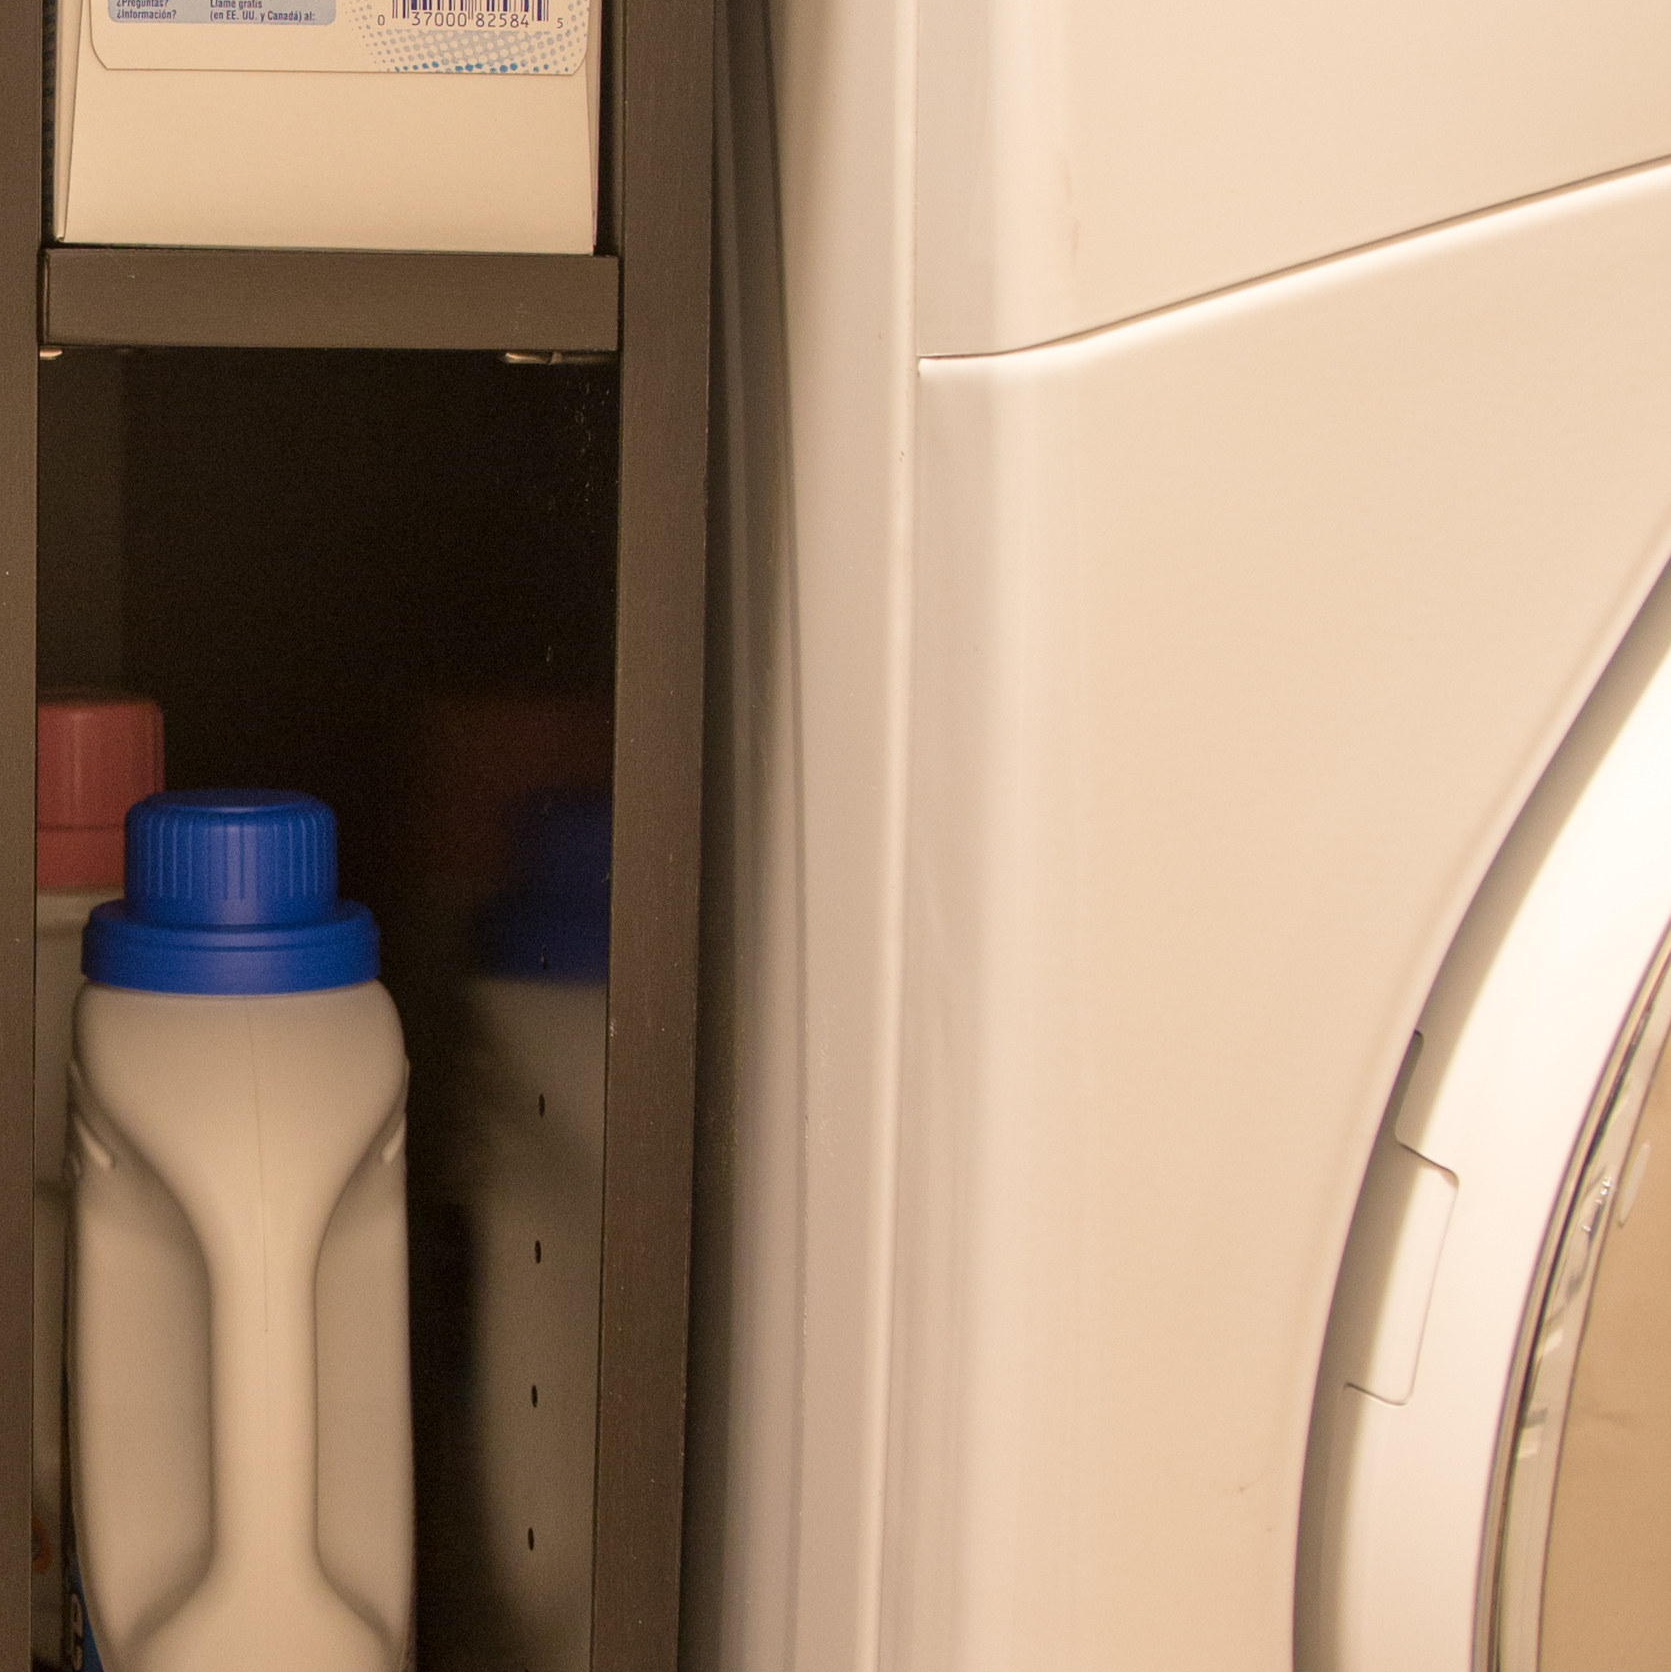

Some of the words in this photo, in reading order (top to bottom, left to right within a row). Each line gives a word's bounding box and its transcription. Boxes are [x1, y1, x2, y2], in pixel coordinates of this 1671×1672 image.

[116, 9, 177, 20] ¿Información?
[210, 11, 224, 22] (en
[226, 10, 240, 21] EE.
[242, 11, 259, 21] UU.
[260, 13, 266, 22] y
[303, 11, 316, 21] al:
[377, 14, 386, 26] 0
[411, 11, 467, 27] 37000
[475, 12, 530, 28] 82584
[556, 17, 564, 29] 5
